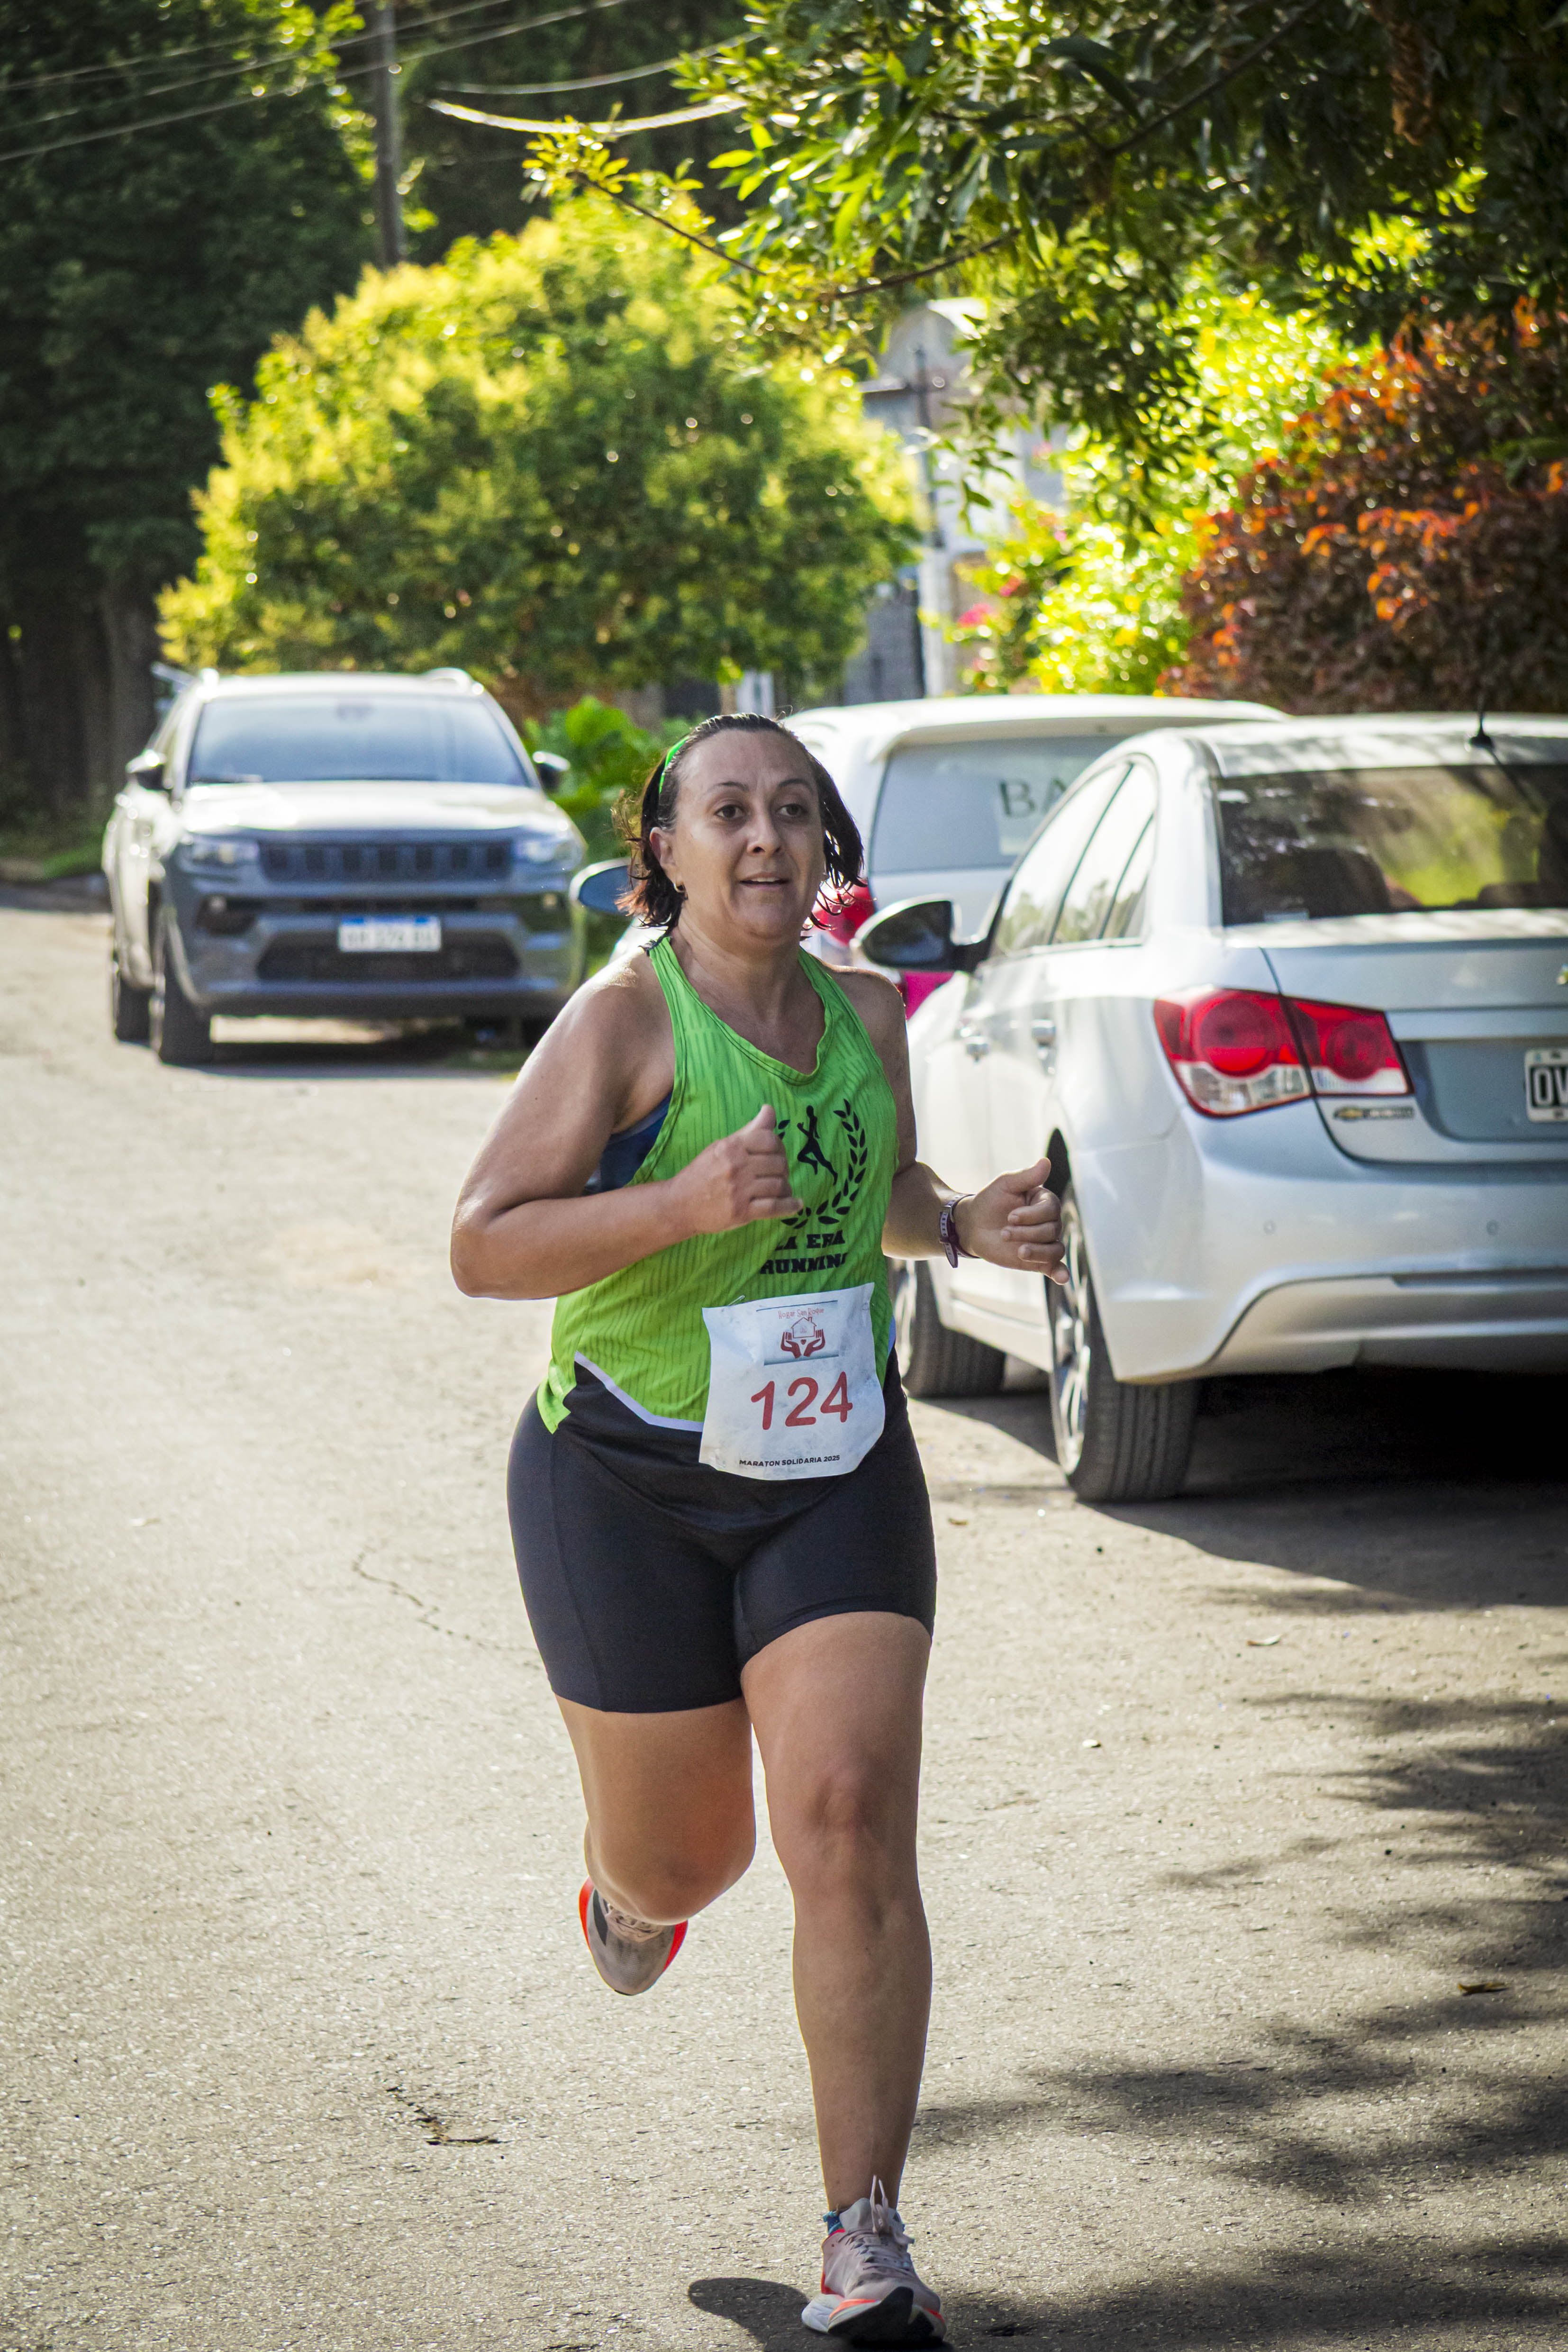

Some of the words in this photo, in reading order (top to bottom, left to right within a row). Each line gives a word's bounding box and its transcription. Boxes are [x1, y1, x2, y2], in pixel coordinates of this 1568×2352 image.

[797, 1308, 807, 1317] San
[807, 1308, 824, 1317] Roque
[751, 1371, 853, 1430] 124
[781, 1457, 822, 1465] SOLIDARIA
